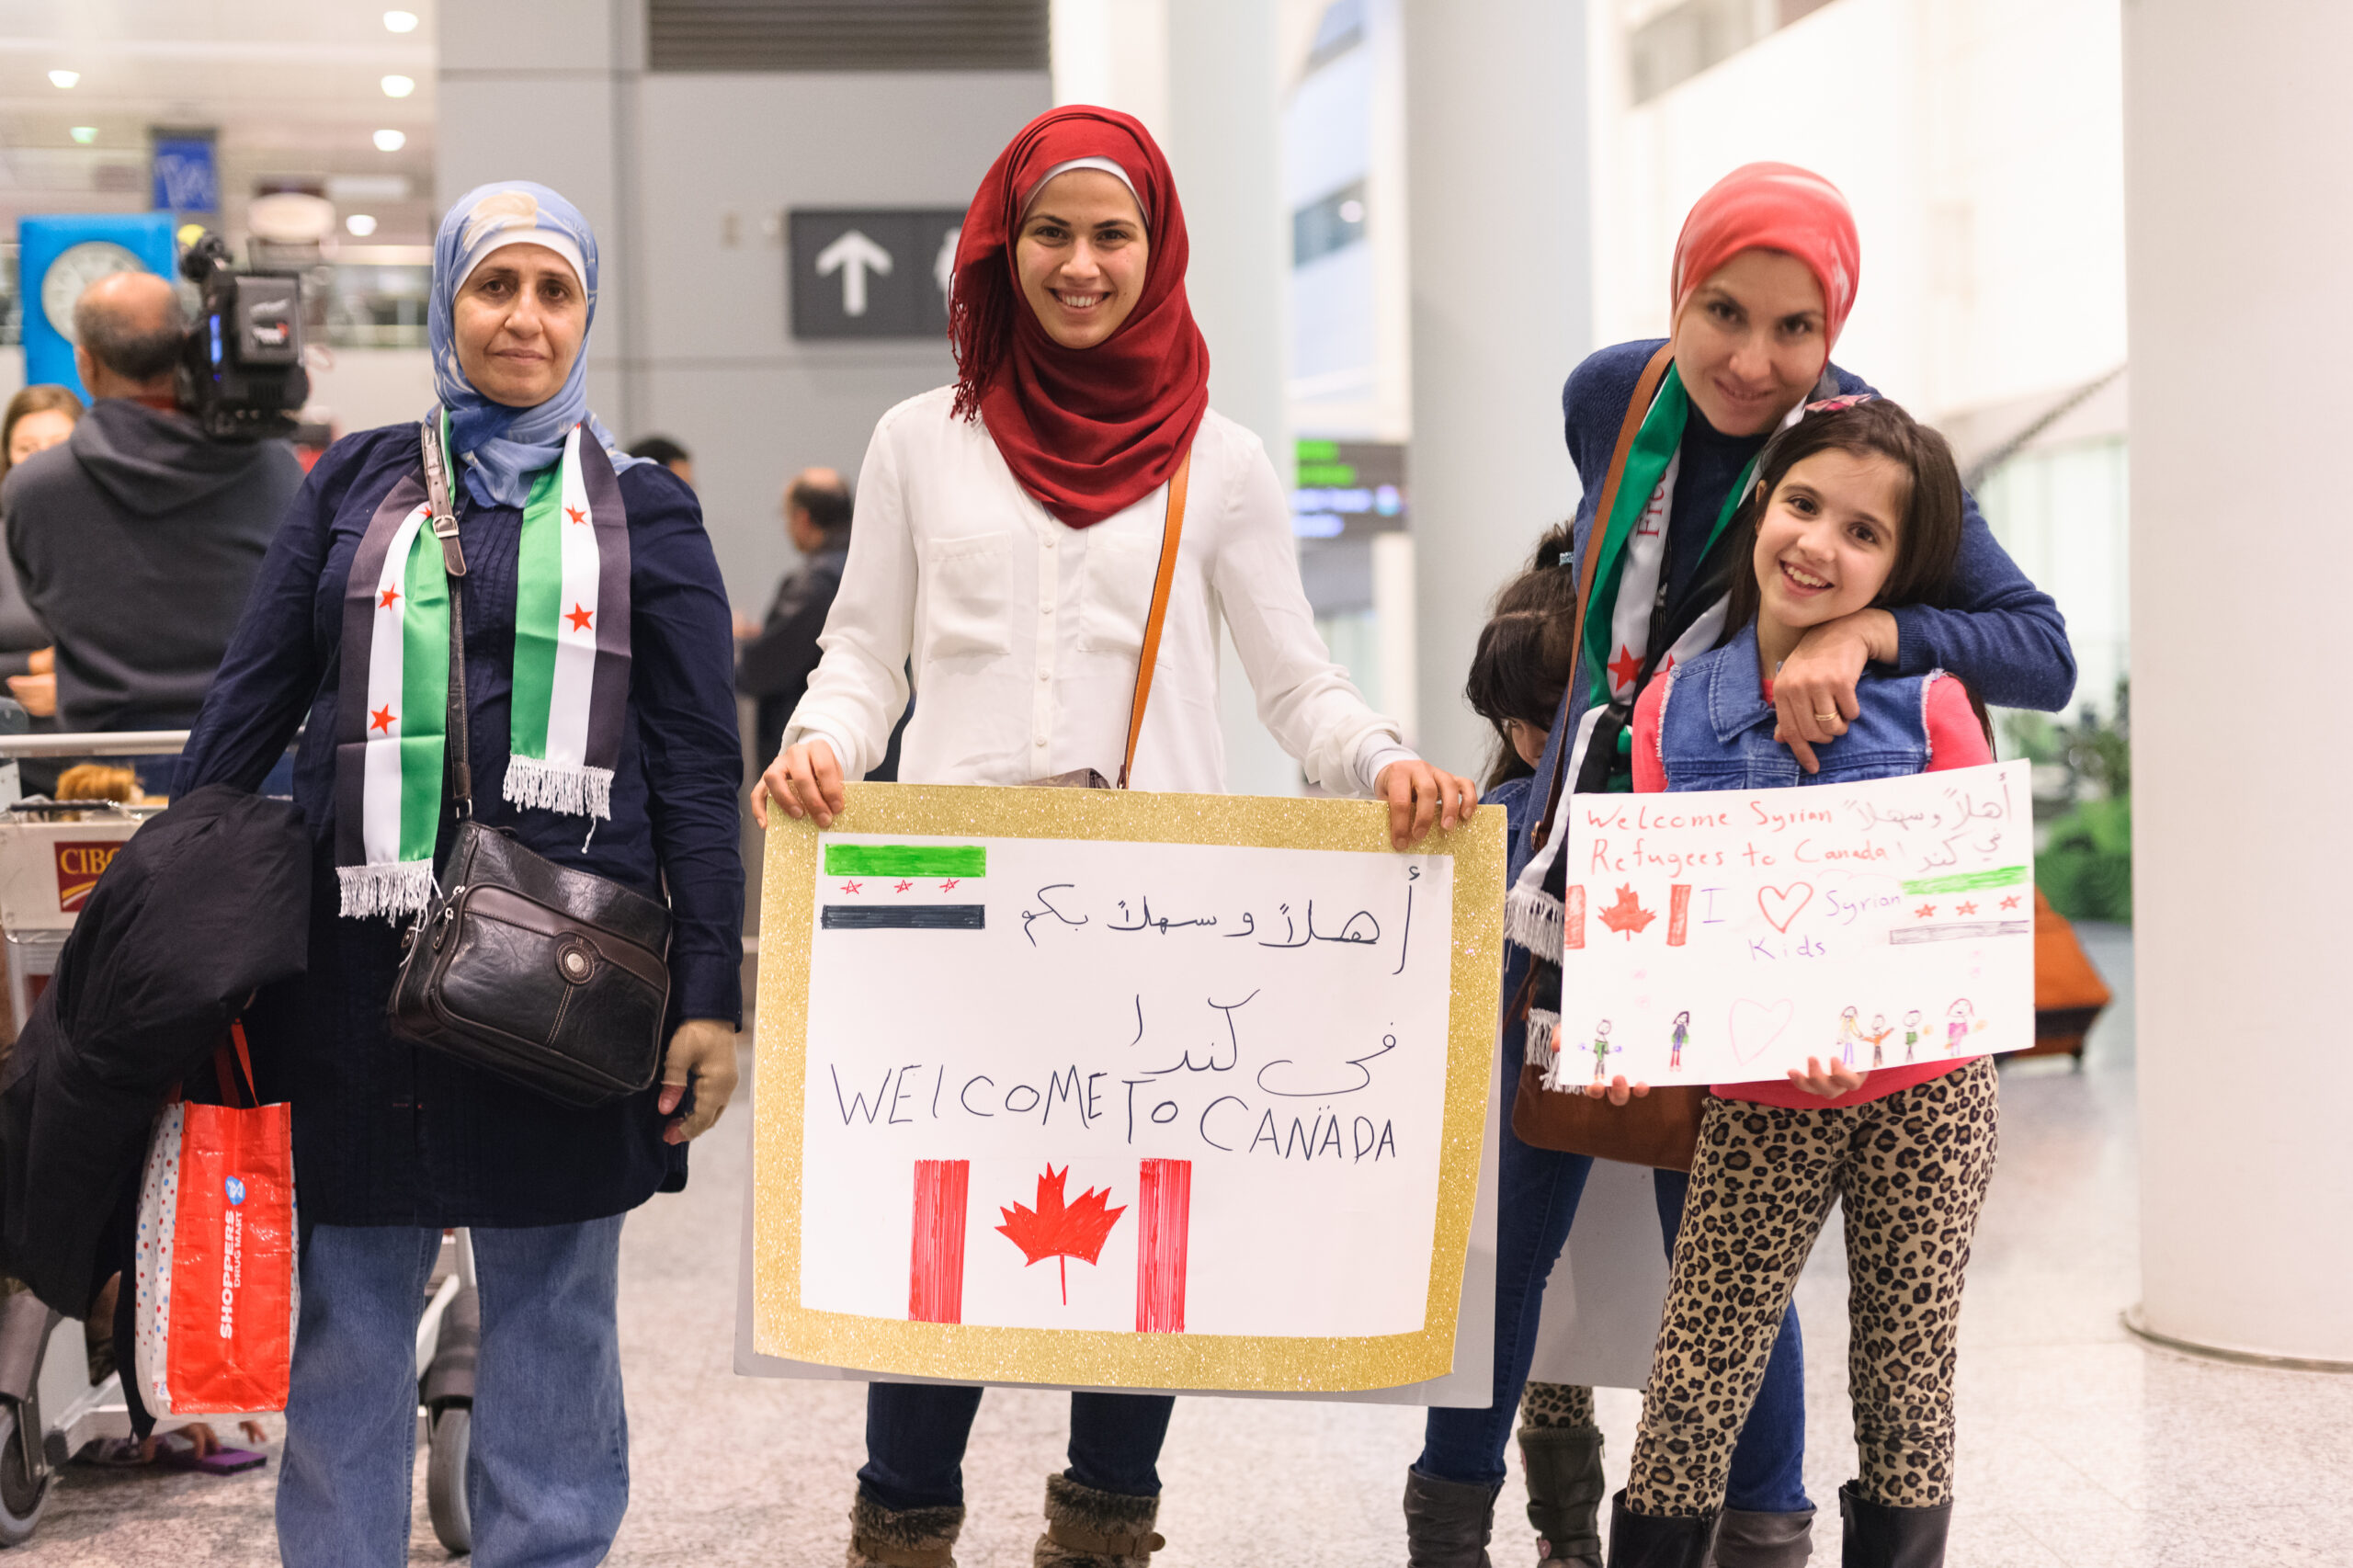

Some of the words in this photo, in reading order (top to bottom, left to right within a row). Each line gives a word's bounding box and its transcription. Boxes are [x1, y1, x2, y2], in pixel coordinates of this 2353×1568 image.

[1587, 804, 1731, 831] Welcome
[1749, 801, 1832, 833] Syrian
[1591, 837, 1723, 879] Refugees
[1742, 841, 1776, 867] to
[1793, 837, 1889, 863] Canada
[1021, 884, 1089, 948] بكم
[1699, 887, 1727, 925] I
[1825, 889, 1901, 926] Syrian
[1748, 933, 1826, 961] Kids
[1200, 1096, 1396, 1165] CANADA
[234, 1210, 244, 1245] MART
[220, 1210, 234, 1340] SHOPPERS
[233, 1249, 242, 1288] DRUG
